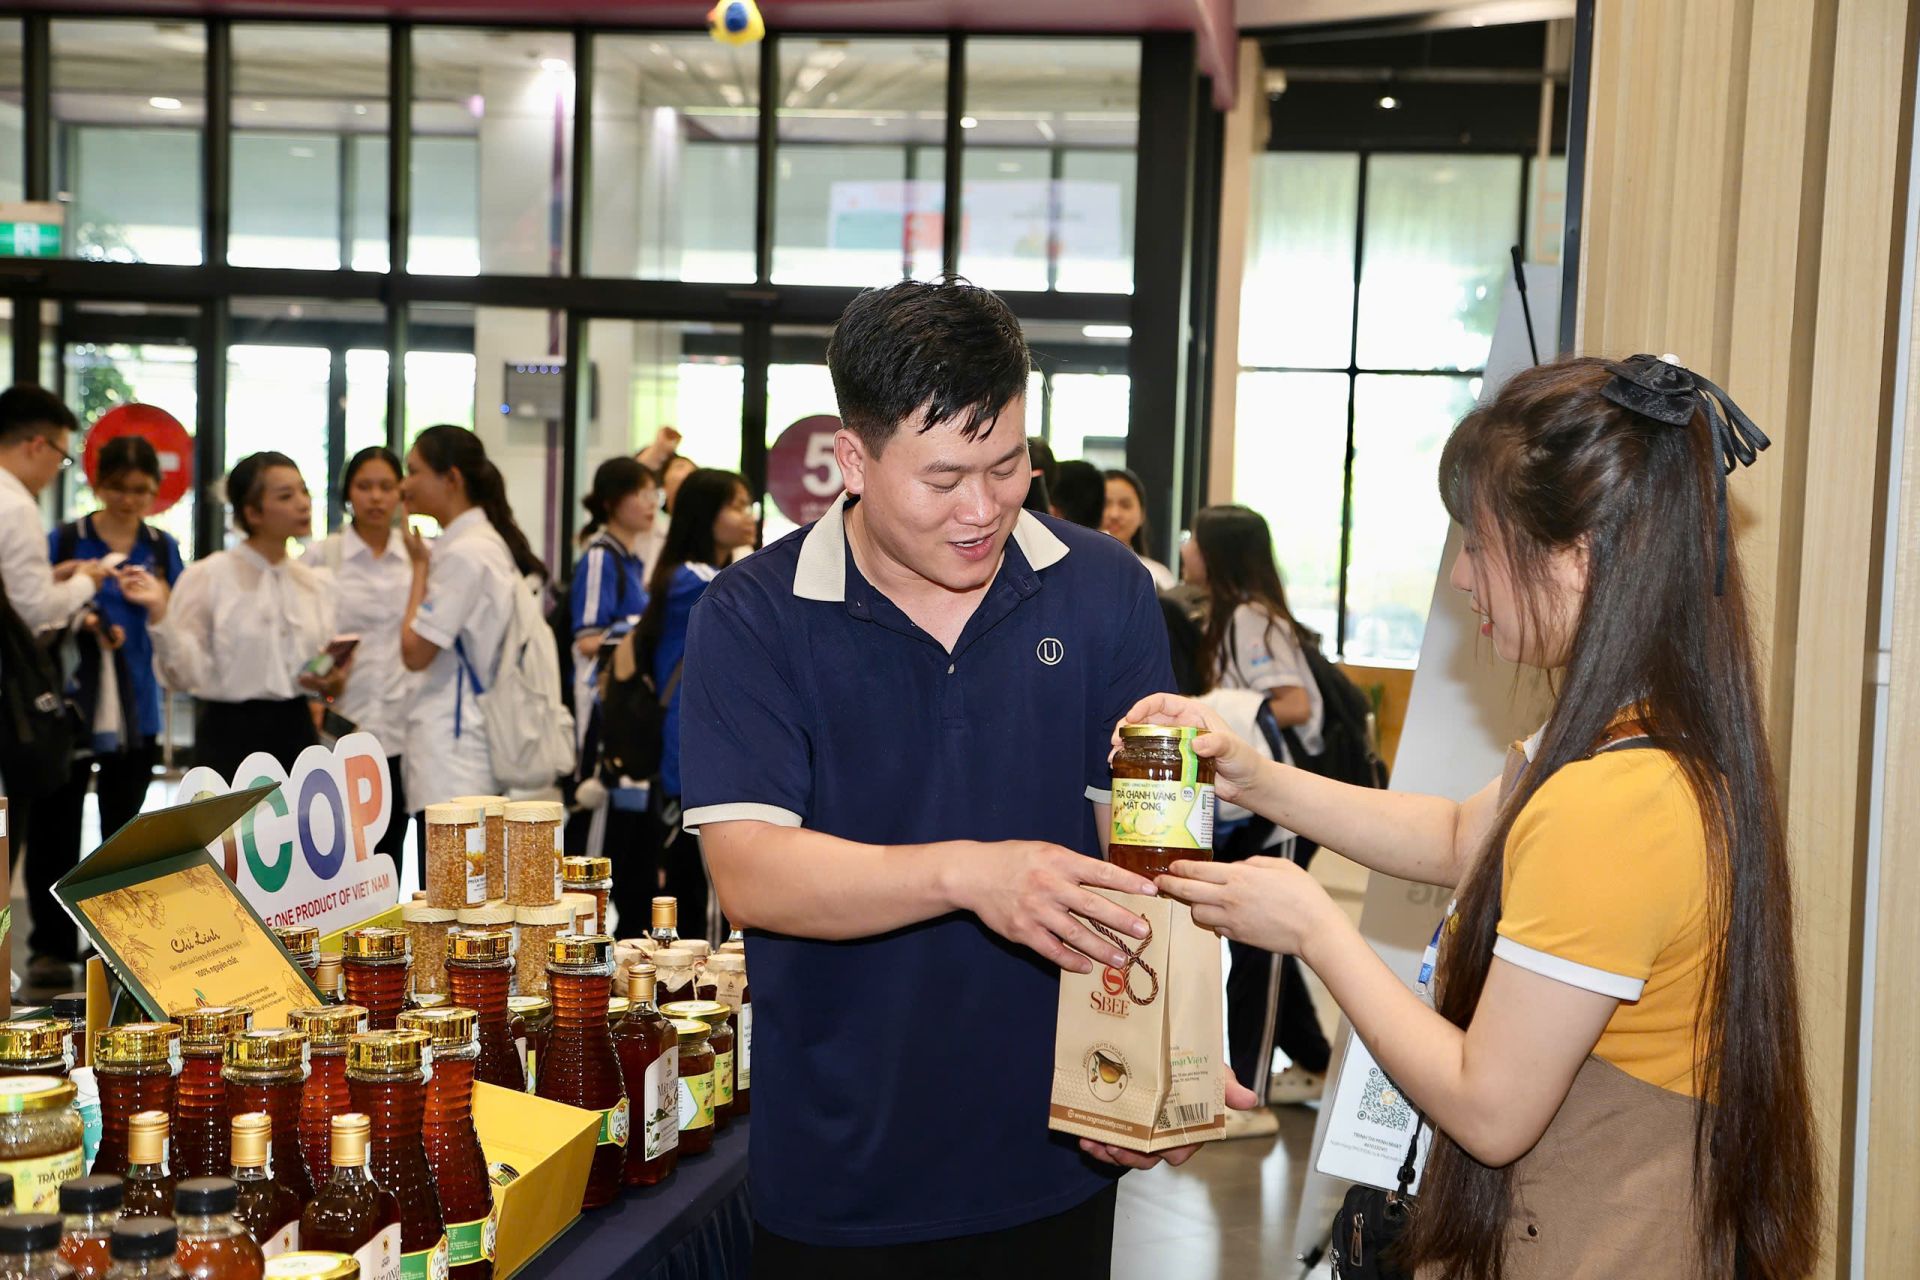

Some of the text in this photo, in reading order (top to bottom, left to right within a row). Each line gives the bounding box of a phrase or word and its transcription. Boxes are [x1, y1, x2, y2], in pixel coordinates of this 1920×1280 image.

[802, 432, 844, 497] 5
[1125, 789, 1151, 800] CHANH
[1140, 801, 1161, 811] ONG
[191, 755, 383, 893] COP
[274, 909, 295, 928] ONE
[295, 892, 337, 923] PRODUCT
[339, 887, 351, 906] OF
[351, 880, 370, 900] VIET
[371, 873, 390, 893] NAM
[195, 928, 220, 945] Linh
[1090, 991, 1130, 1016] SBEE
